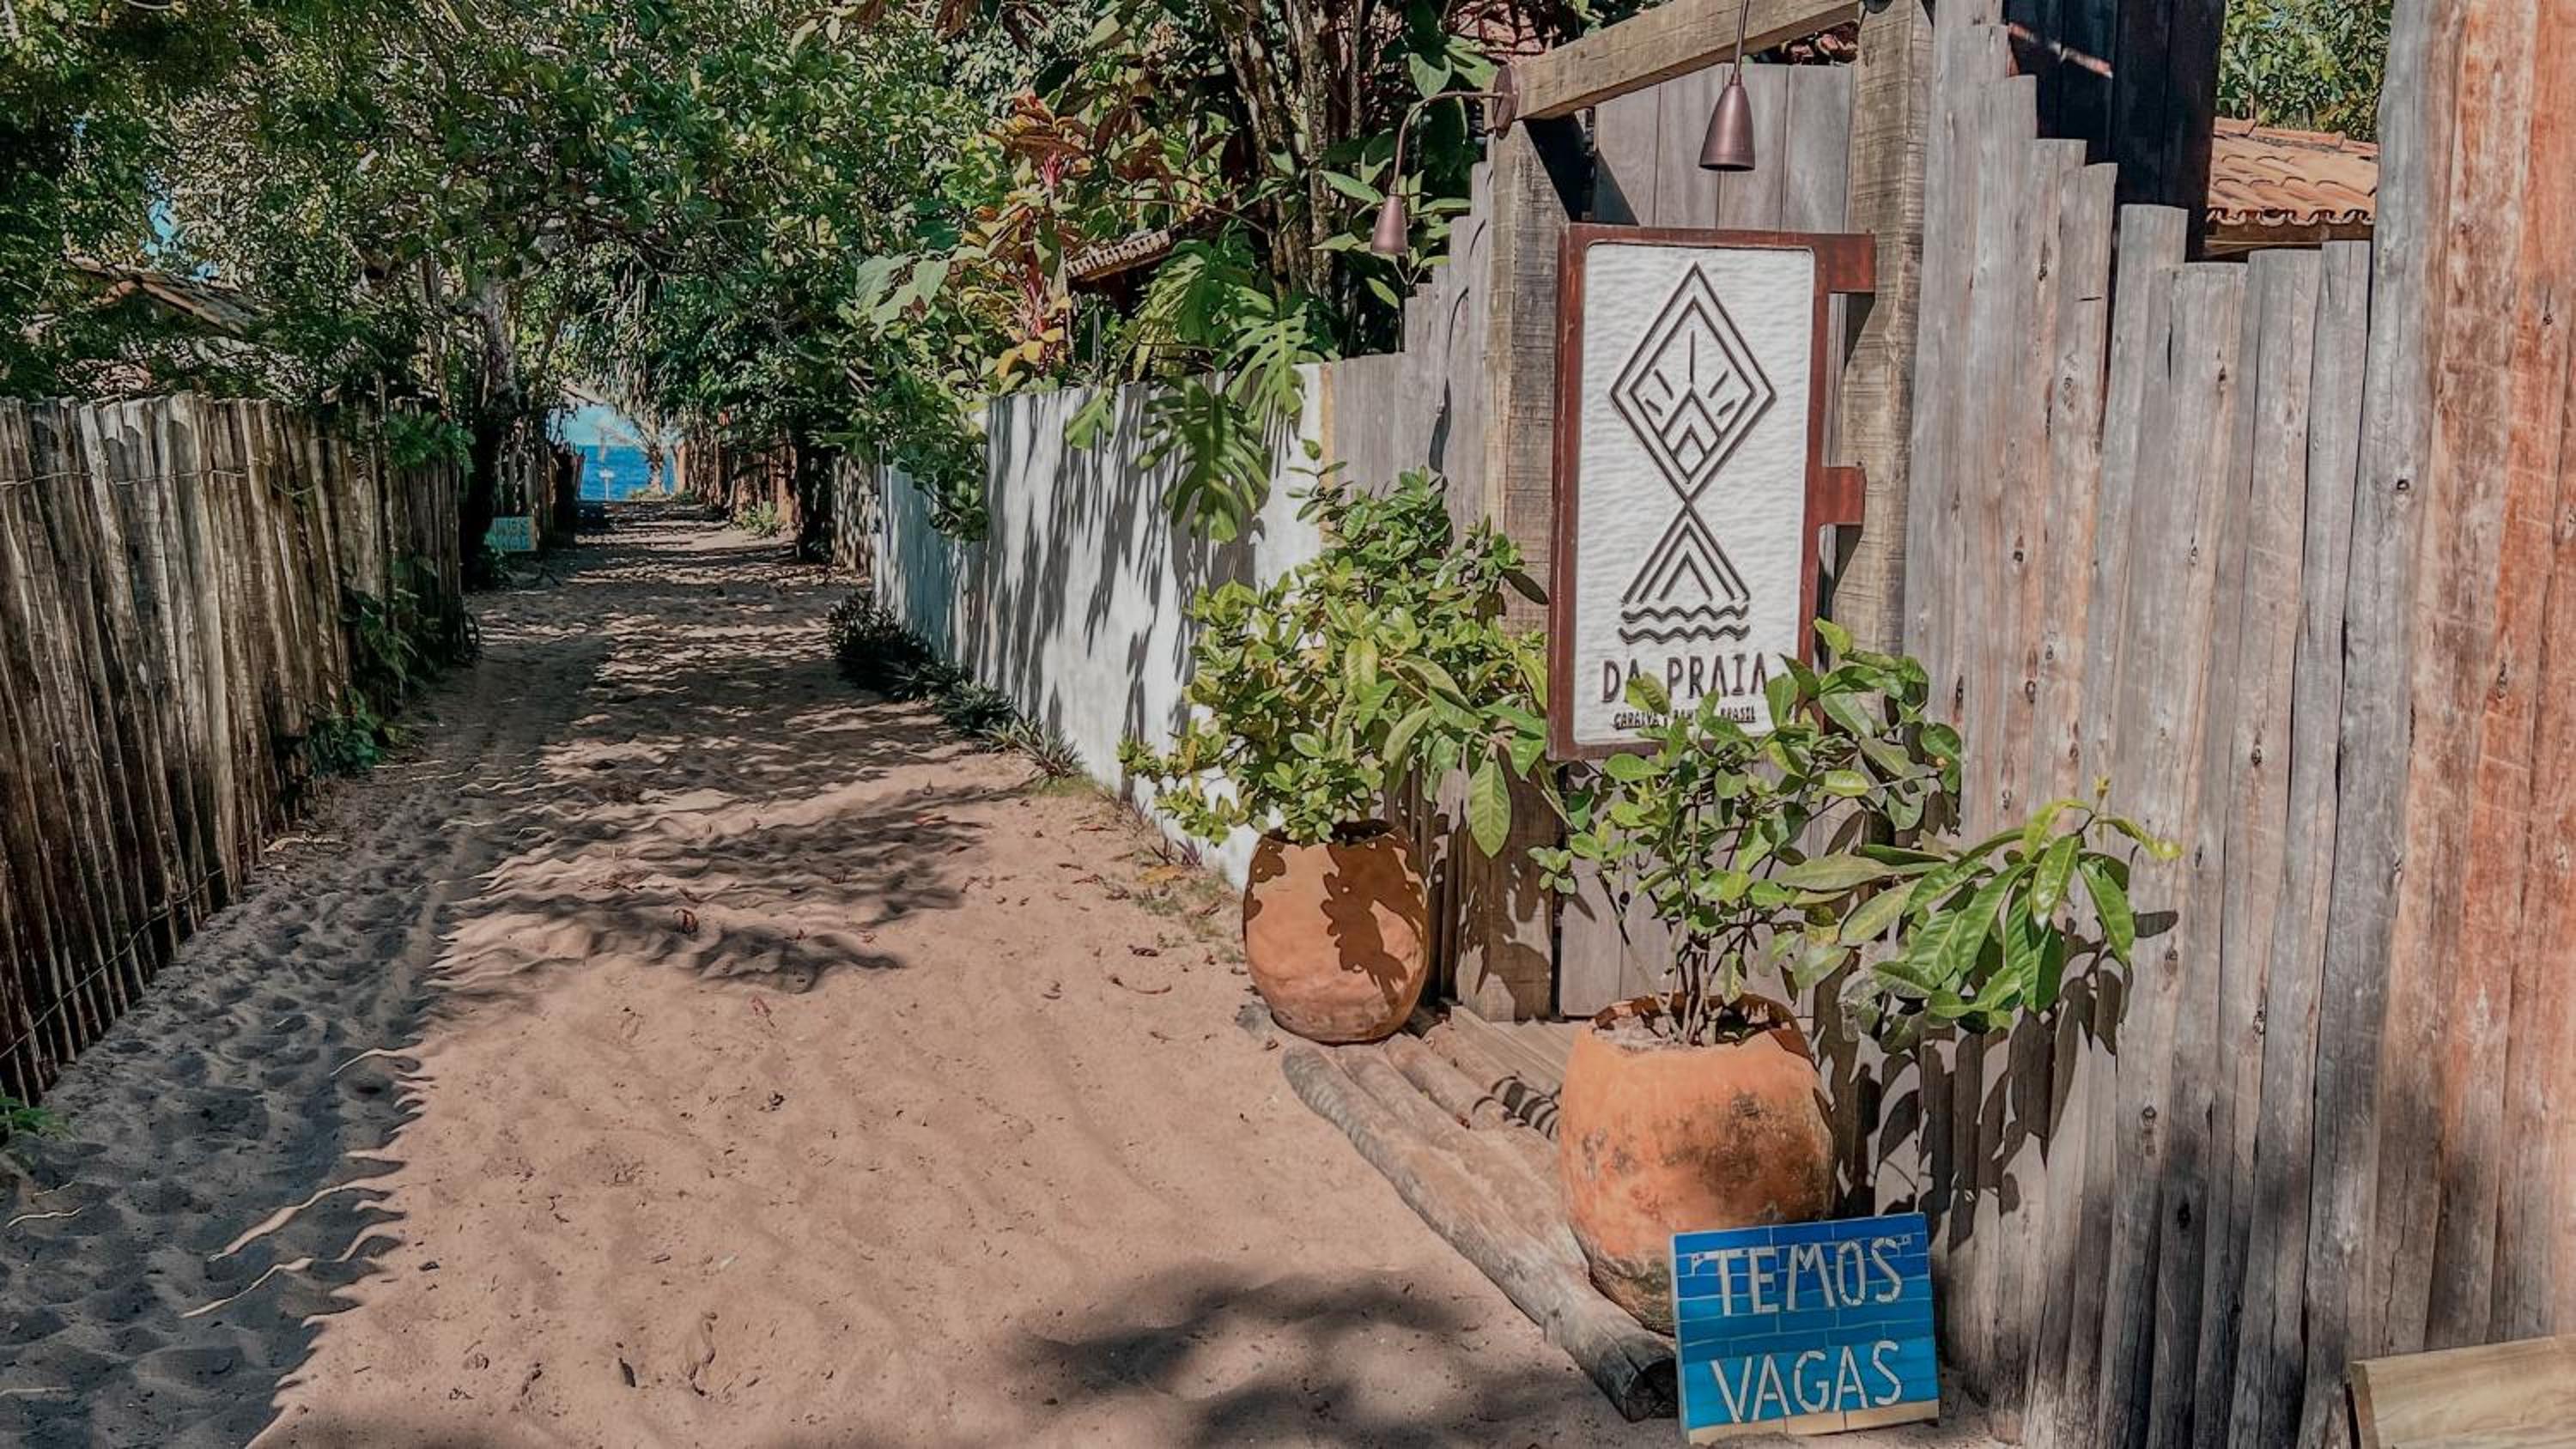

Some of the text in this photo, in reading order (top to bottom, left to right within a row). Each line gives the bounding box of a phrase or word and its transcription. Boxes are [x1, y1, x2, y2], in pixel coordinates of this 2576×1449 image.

[1667, 652, 1766, 699] PRAIA
[1702, 1237, 1902, 1317] TEMOS
[1710, 1340, 1902, 1423] VAGAS
